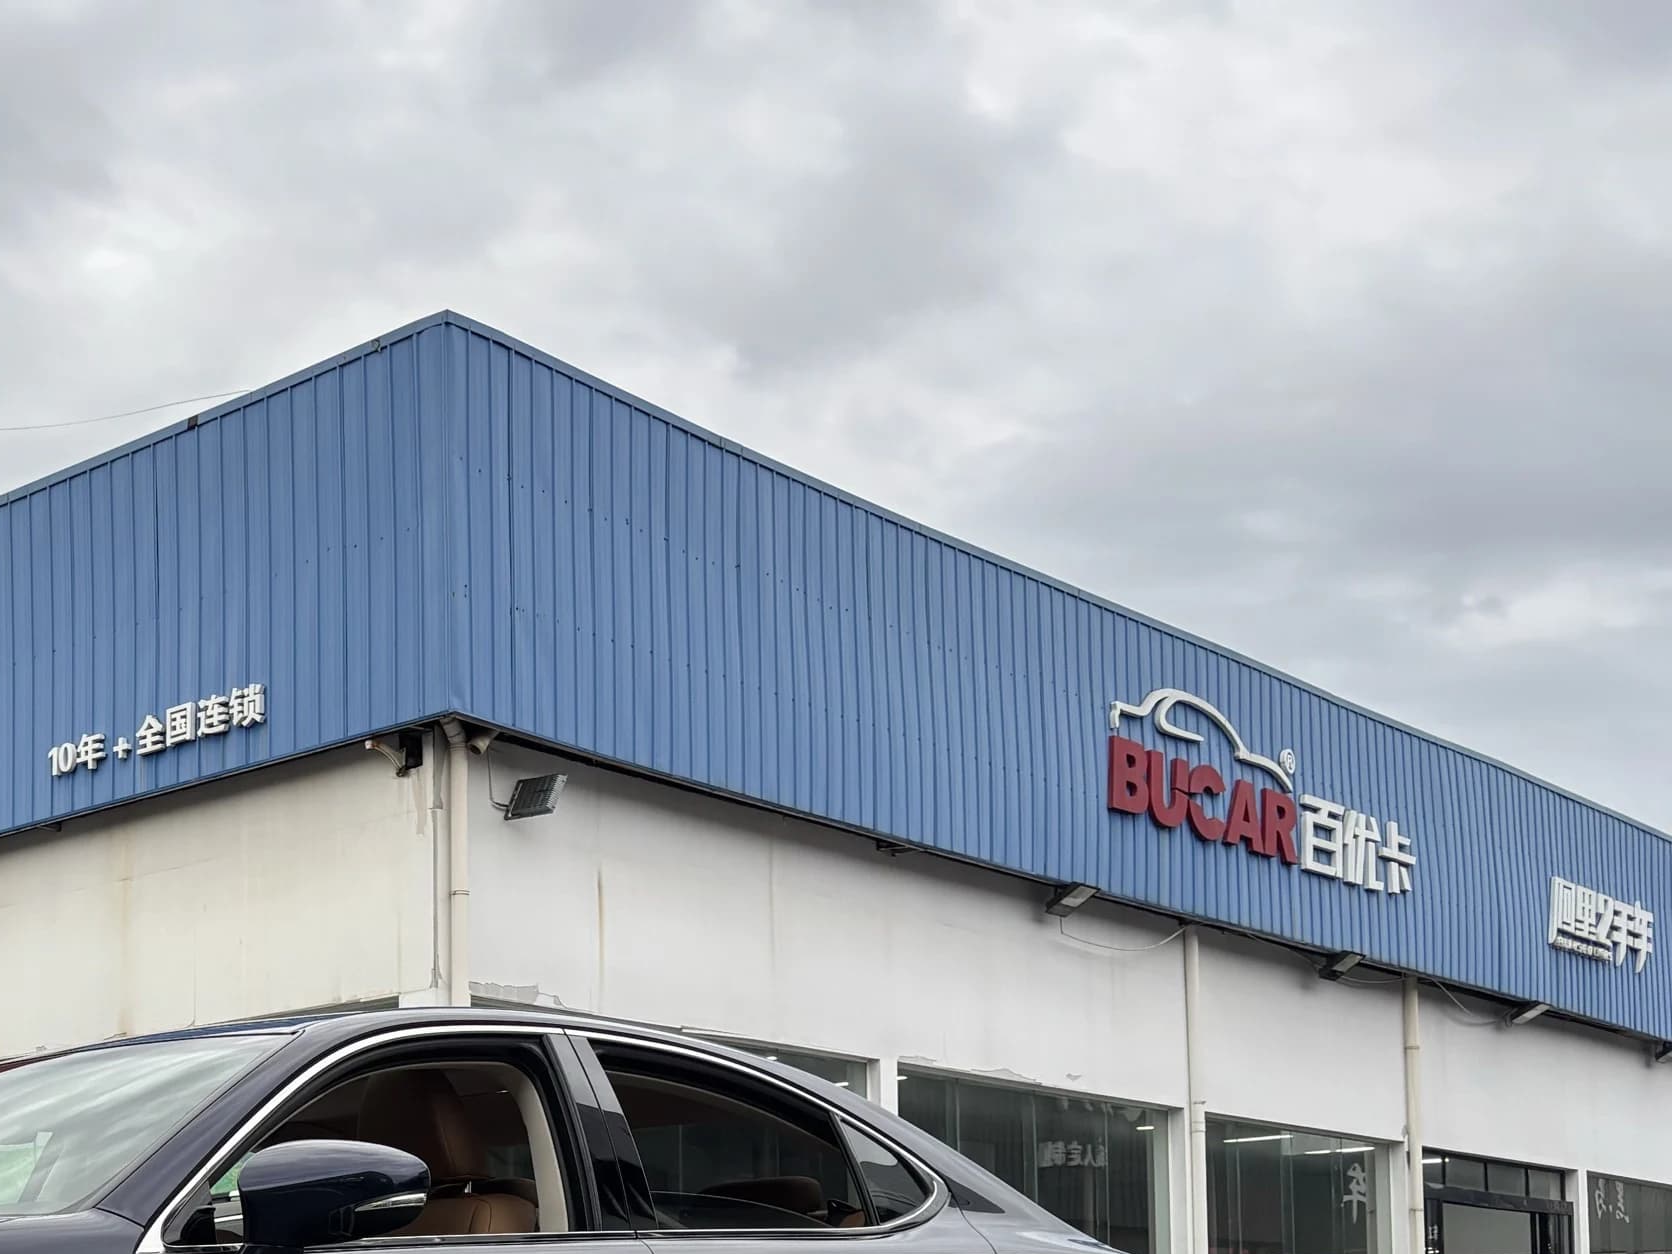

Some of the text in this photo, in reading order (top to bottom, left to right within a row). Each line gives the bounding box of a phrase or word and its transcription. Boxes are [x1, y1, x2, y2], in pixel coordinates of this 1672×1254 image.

[48, 733, 106, 776] 10年
[136, 683, 266, 756] 全国连锁
[1108, 735, 1416, 894] BUCAR 百优卡
